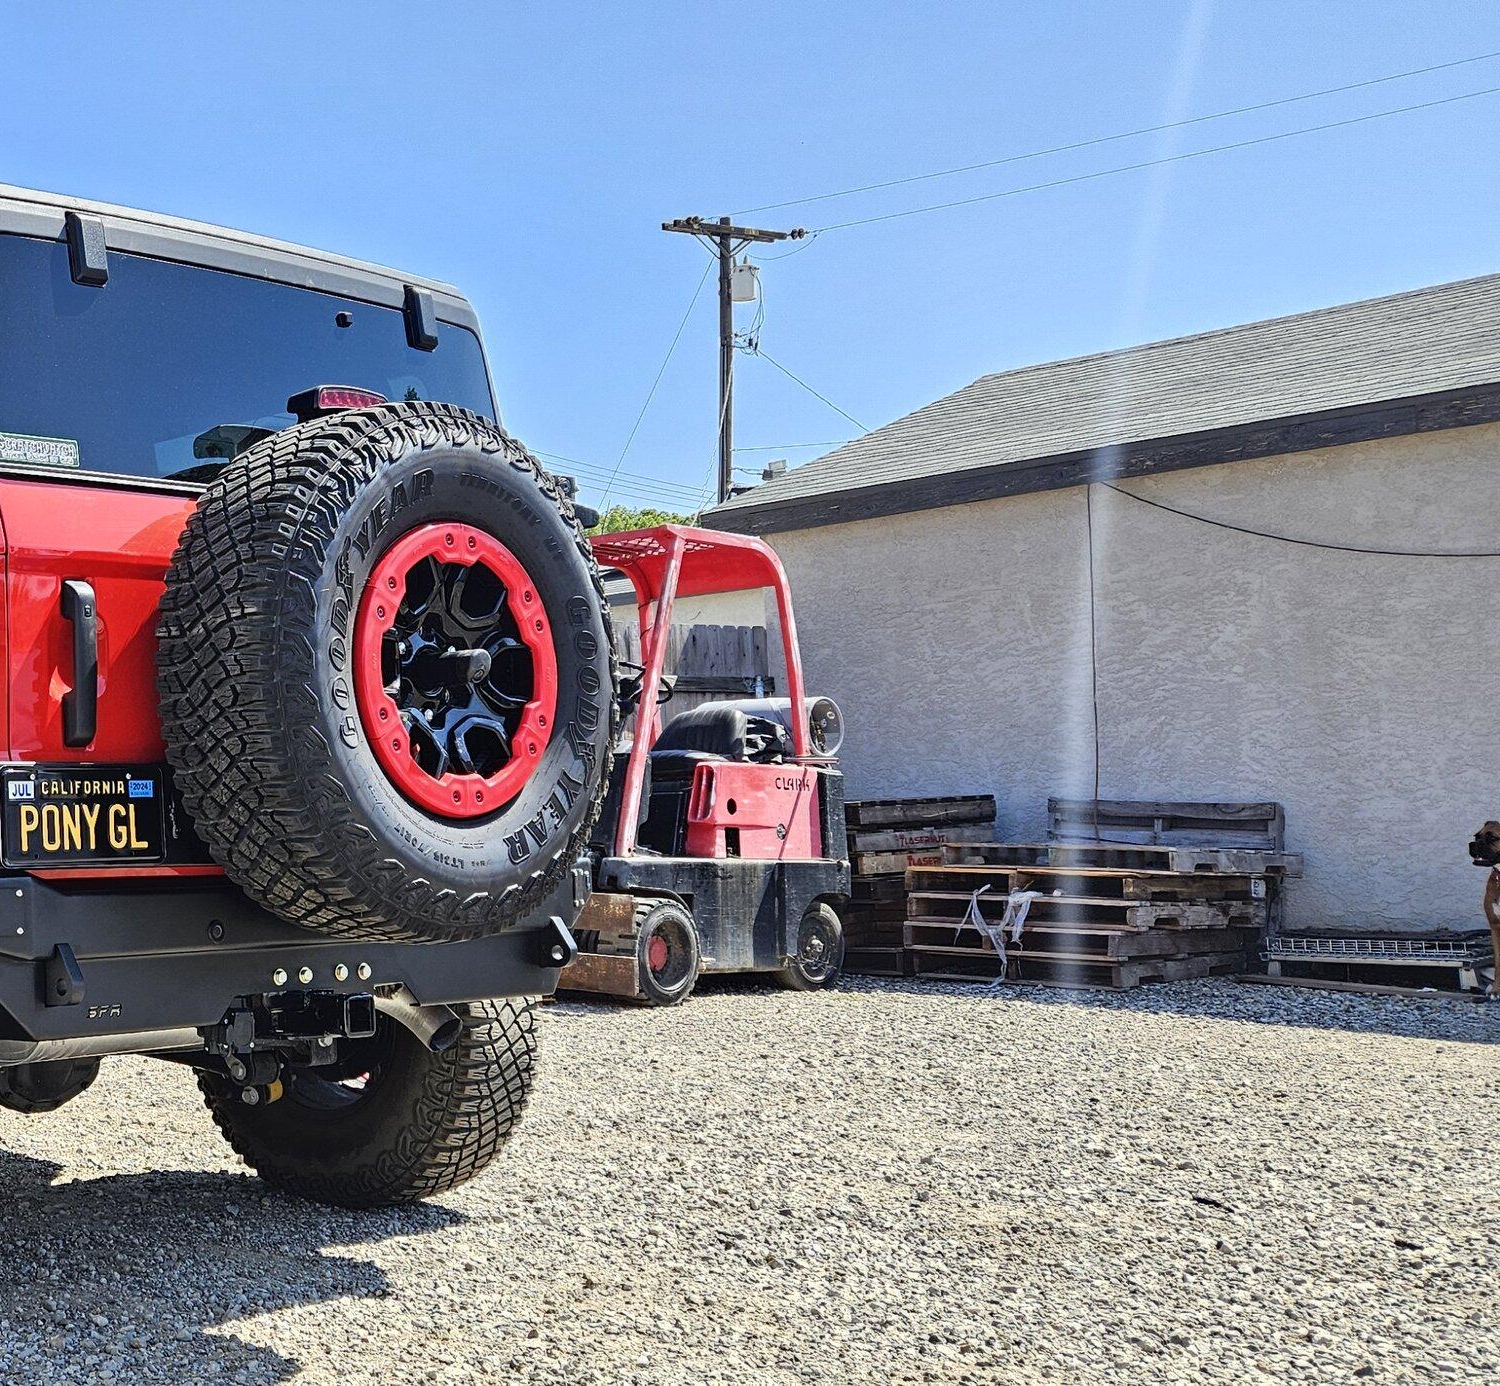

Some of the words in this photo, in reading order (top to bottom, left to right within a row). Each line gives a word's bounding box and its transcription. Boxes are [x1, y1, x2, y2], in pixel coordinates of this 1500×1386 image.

[12, 783, 32, 797] JUL
[41, 780, 125, 795] CALIFORNIA
[132, 783, 148, 791] 2024
[775, 777, 810, 791] CLARK
[20, 803, 100, 852] PONY
[109, 803, 149, 850] GL
[87, 1003, 122, 1018] SFR
